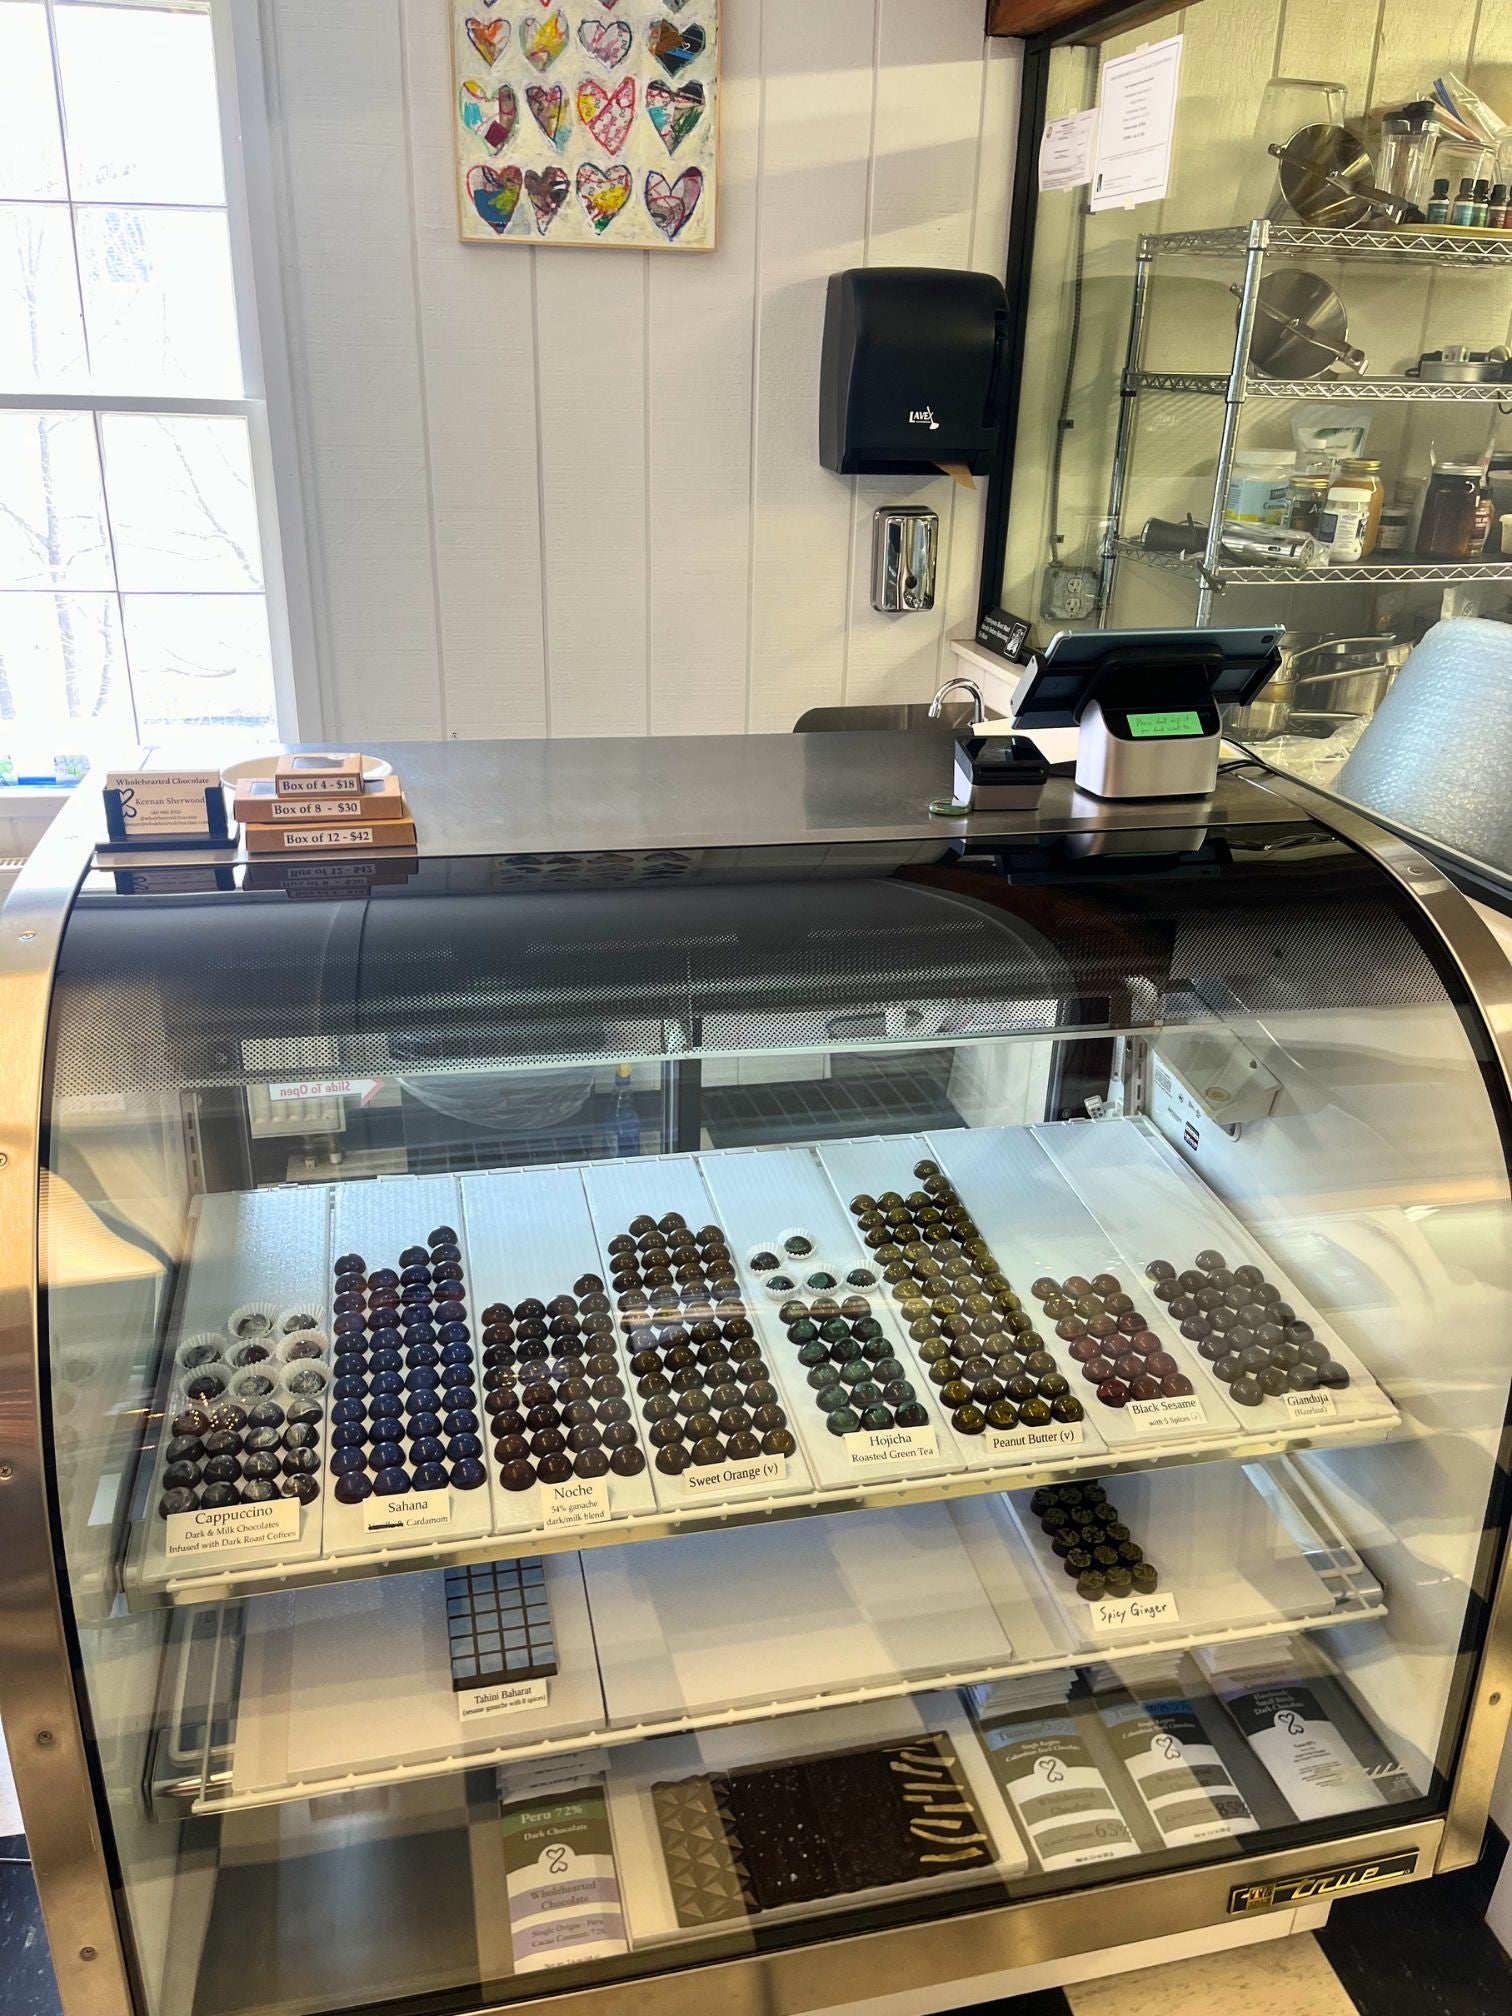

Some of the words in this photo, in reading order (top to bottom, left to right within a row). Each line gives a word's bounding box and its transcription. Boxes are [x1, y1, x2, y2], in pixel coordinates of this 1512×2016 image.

[116, 777, 170, 786] Wholehearted
[172, 777, 209, 785] Chocolate
[282, 780, 303, 791] Box
[306, 780, 317, 790] of
[320, 780, 327, 790] 4
[336, 779, 355, 790] $18
[135, 798, 164, 806] Keenan
[166, 796, 205, 805] Sherwood
[274, 804, 297, 815] Box
[299, 803, 312, 814] of
[314, 803, 322, 813] 8
[337, 802, 358, 813] $30
[286, 834, 309, 844] Box
[311, 833, 324, 843] of
[328, 832, 340, 842] 12
[350, 831, 370, 841] $42
[1132, 1402, 1160, 1415] Black
[1161, 1399, 1196, 1411] Sesame
[1287, 1393, 1329, 1406] Gianduja
[1148, 1418, 1163, 1426] with
[869, 1434, 912, 1448] Hojicha
[993, 1437, 1027, 1449] Peanut
[1028, 1432, 1058, 1445] Butter
[1060, 1429, 1075, 1443] (v)
[851, 1451, 888, 1463] Roasted
[889, 1449, 917, 1459] Green
[917, 1447, 934, 1457] Tea
[689, 1474, 721, 1488] Sweet
[723, 1467, 761, 1481] Orange
[763, 1462, 778, 1476] (v)
[554, 1484, 593, 1500] Noche
[388, 1500, 428, 1513] Sahana
[568, 1500, 598, 1513] ganache
[195, 1506, 273, 1526] Cappuccino
[546, 1513, 583, 1526] dark/milk
[583, 1509, 605, 1521] blend
[185, 1530, 205, 1539] Dark
[207, 1529, 214, 1537] &
[216, 1526, 235, 1536] Milk
[236, 1521, 280, 1533] Chocolates
[169, 1542, 199, 1554] Infused
[202, 1540, 220, 1549] with
[222, 1537, 241, 1546] Dark
[244, 1534, 265, 1544] Roast
[1100, 1606, 1126, 1624] Spicy
[1130, 1602, 1167, 1618] Ginger
[474, 1691, 500, 1704] Tahini
[501, 1687, 532, 1700] Baharat
[521, 1812, 551, 1824] Peru
[554, 1804, 583, 1817] 72%
[1215, 1799, 1251, 1817] 85%
[523, 1830, 545, 1841] Dark
[546, 1823, 588, 1836] Chocolate
[1095, 1821, 1135, 1842] 65%
[530, 1880, 597, 1900] Wholehearted
[541, 1895, 589, 1910] Chocolate
